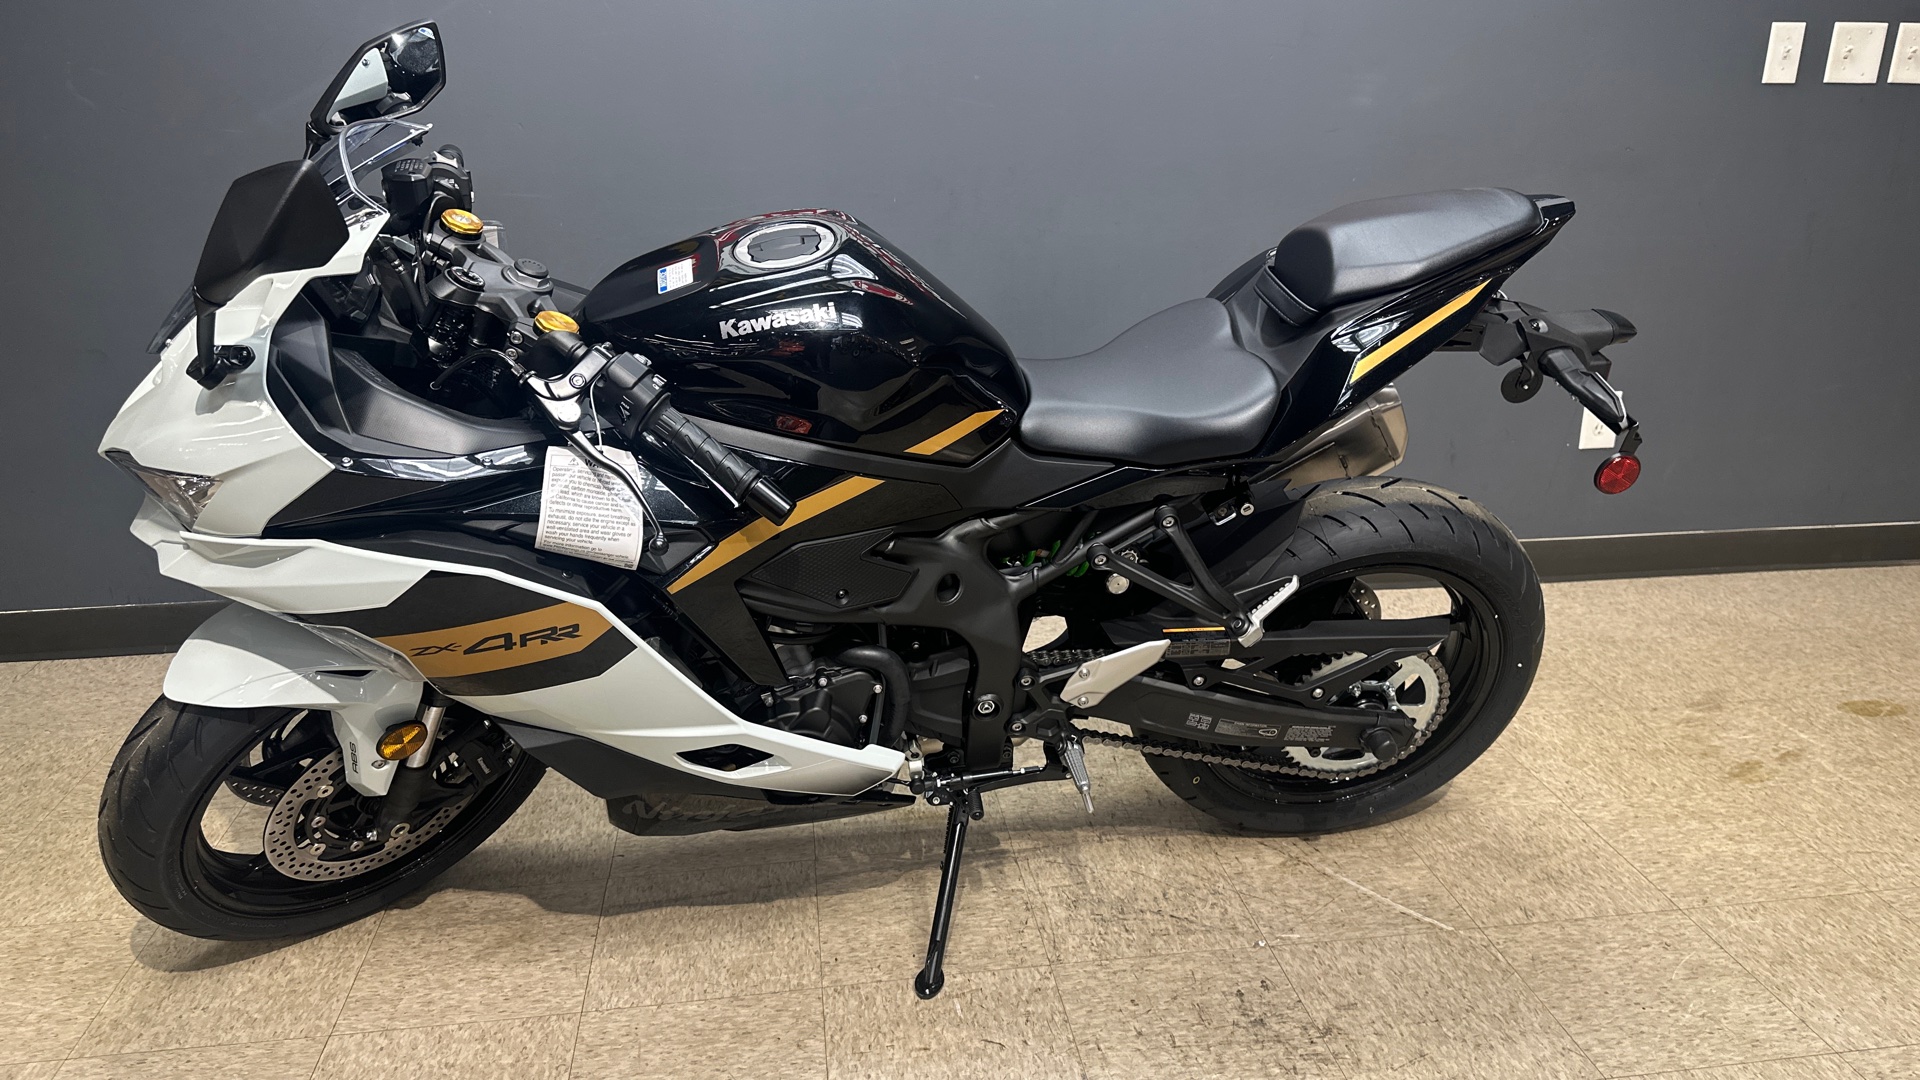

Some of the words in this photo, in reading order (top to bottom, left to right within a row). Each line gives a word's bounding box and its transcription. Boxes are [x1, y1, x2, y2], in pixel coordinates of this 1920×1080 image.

[719, 302, 837, 340] Kawasaki
[556, 494, 576, 502] California
[584, 534, 606, 542] frequently
[350, 742, 359, 774] ABS
